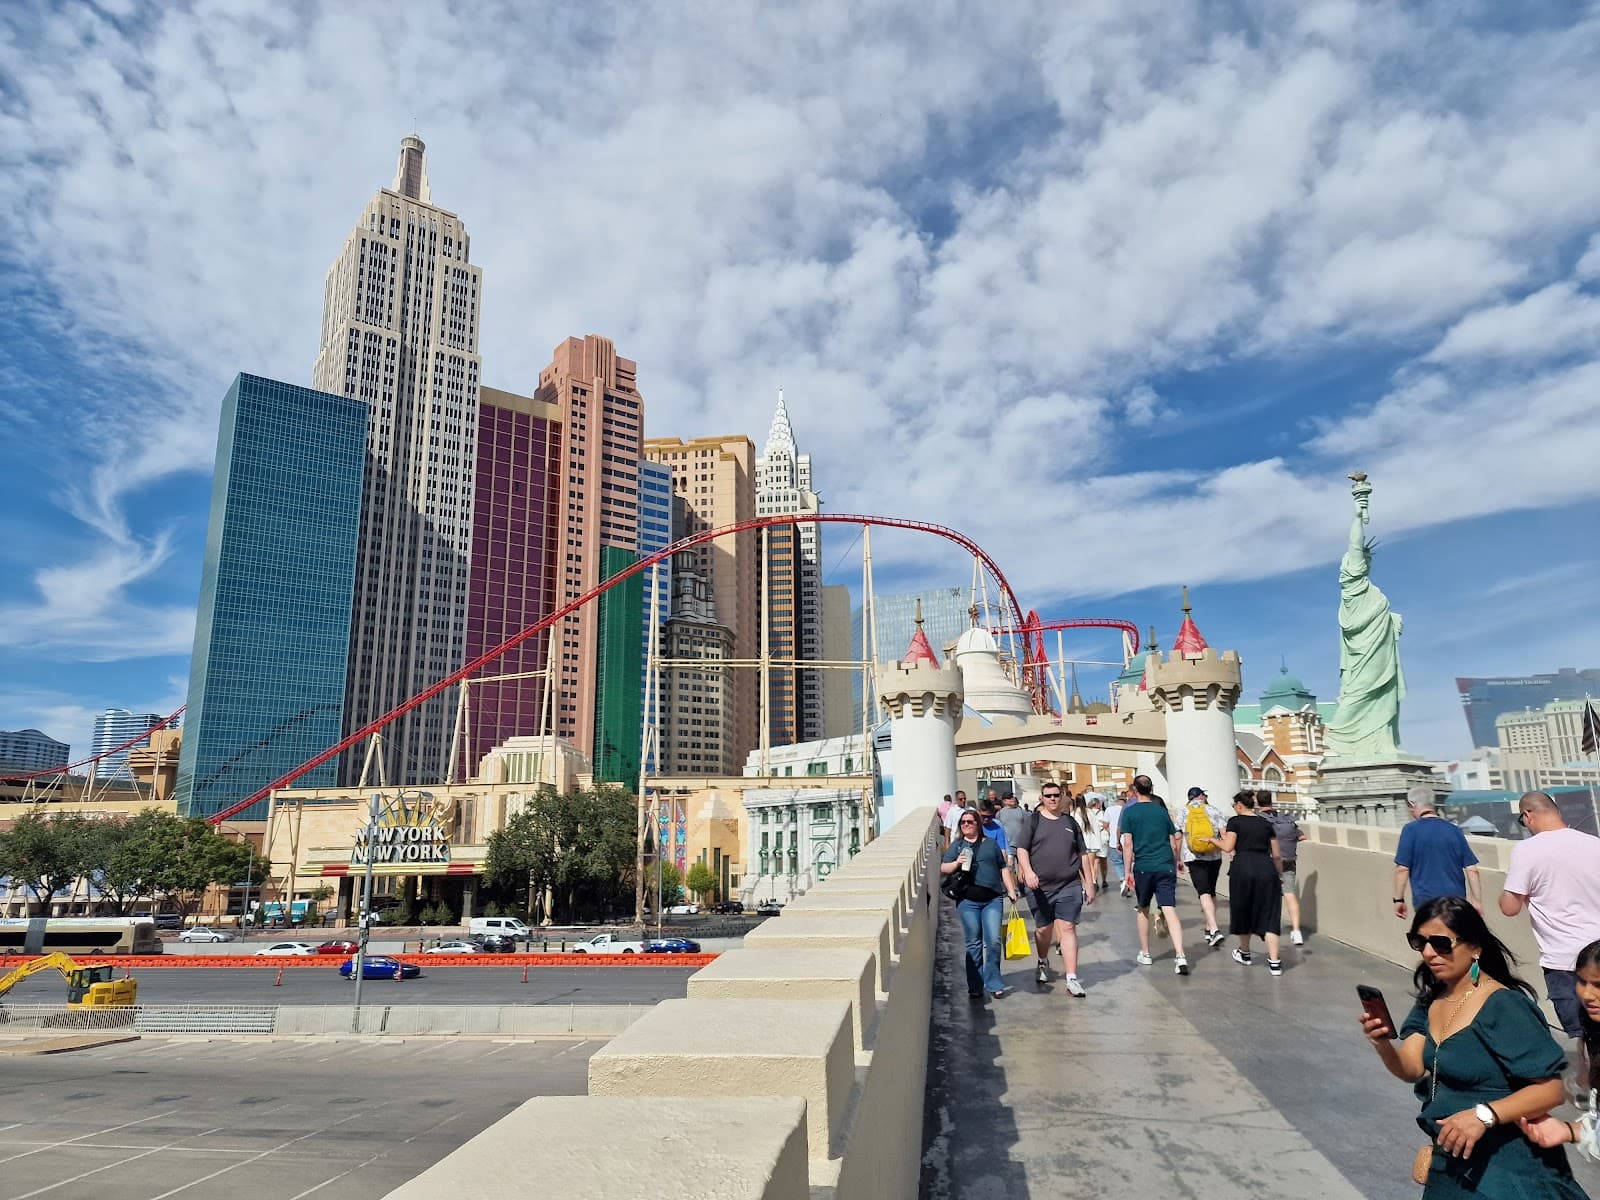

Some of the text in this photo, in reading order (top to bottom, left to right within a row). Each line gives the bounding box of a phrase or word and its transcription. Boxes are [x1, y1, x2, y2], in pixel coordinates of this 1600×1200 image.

[355, 826, 445, 842] NW YORK
[354, 845, 444, 860] NW YORK
